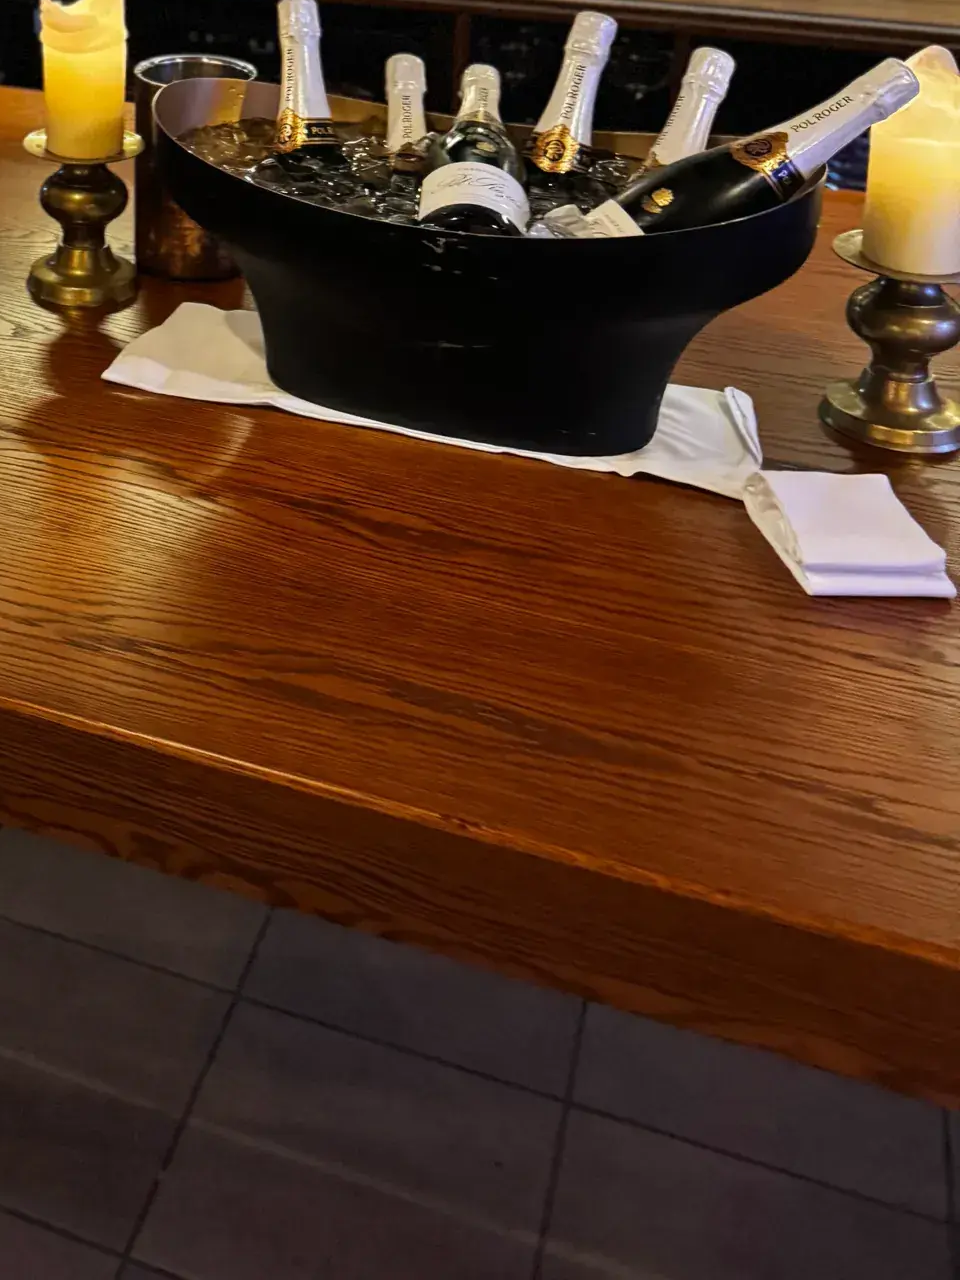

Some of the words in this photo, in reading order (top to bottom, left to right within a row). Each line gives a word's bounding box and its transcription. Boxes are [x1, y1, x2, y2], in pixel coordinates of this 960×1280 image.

[568, 64, 587, 99] ROGER
[402, 94, 412, 123] ROGER
[561, 98, 577, 120] POL
[790, 118, 816, 134] POL
[814, 95, 855, 122] ROGER
[402, 124, 412, 138] POL
